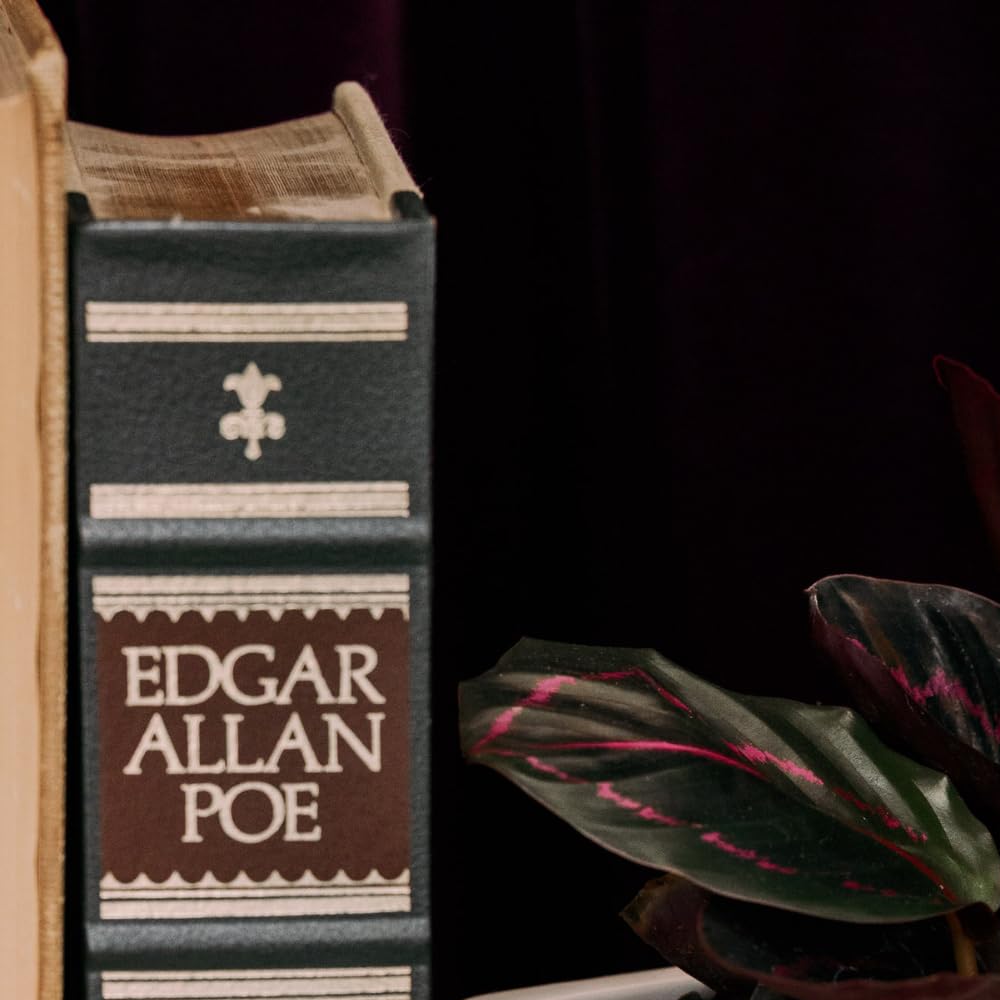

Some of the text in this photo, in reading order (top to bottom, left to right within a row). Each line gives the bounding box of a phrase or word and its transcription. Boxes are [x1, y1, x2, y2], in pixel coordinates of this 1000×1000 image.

[121, 644, 387, 706] EDGAR
[123, 711, 386, 775] ALLAN
[180, 781, 322, 844] POE
